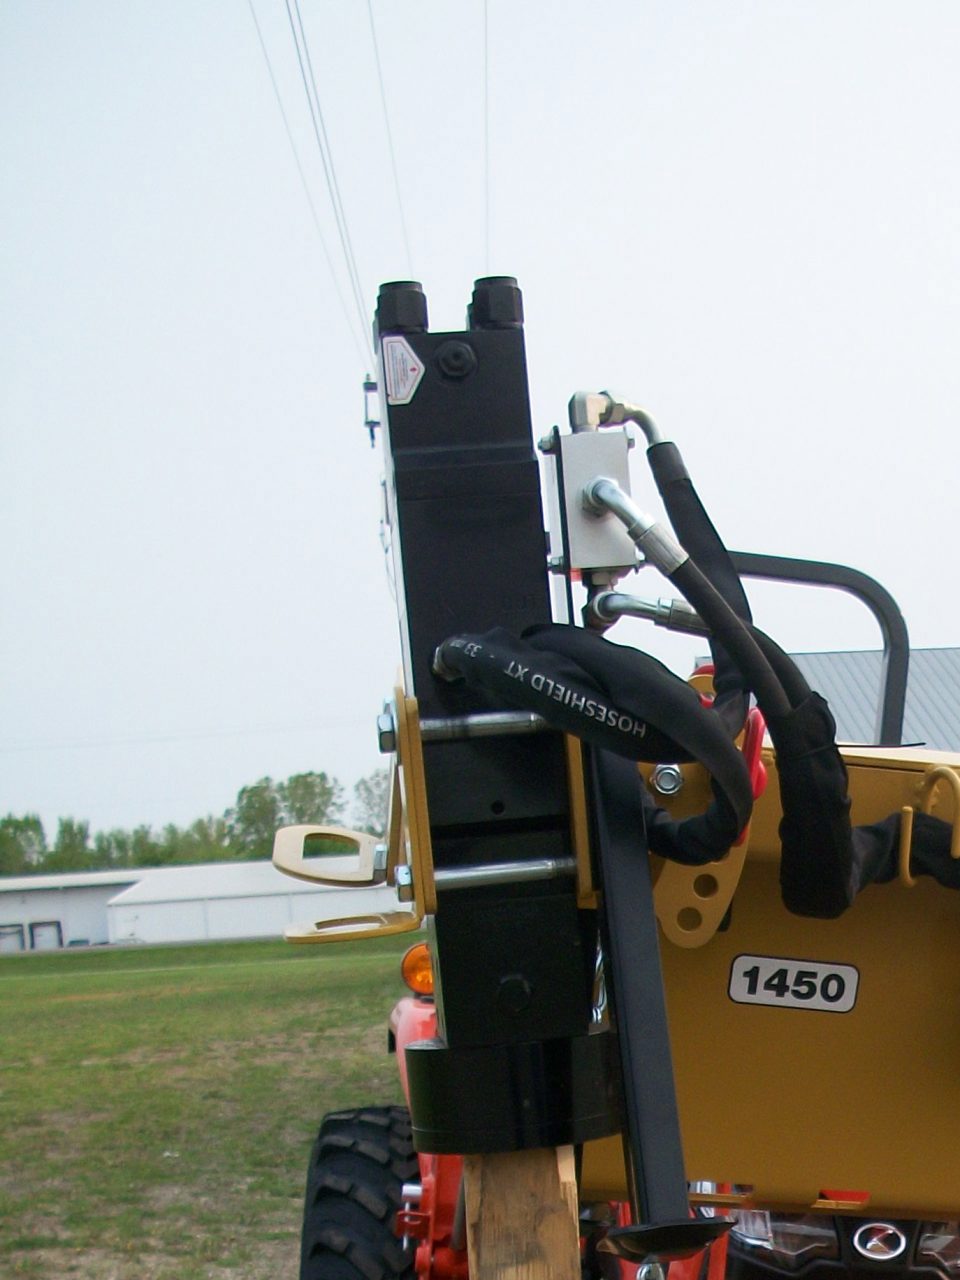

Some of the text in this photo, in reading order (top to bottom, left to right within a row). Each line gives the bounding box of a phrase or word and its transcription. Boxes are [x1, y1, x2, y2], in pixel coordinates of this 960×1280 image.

[503, 660, 529, 683] XT
[531, 674, 646, 739] HOSESHIELD
[743, 966, 845, 1003] 1450
